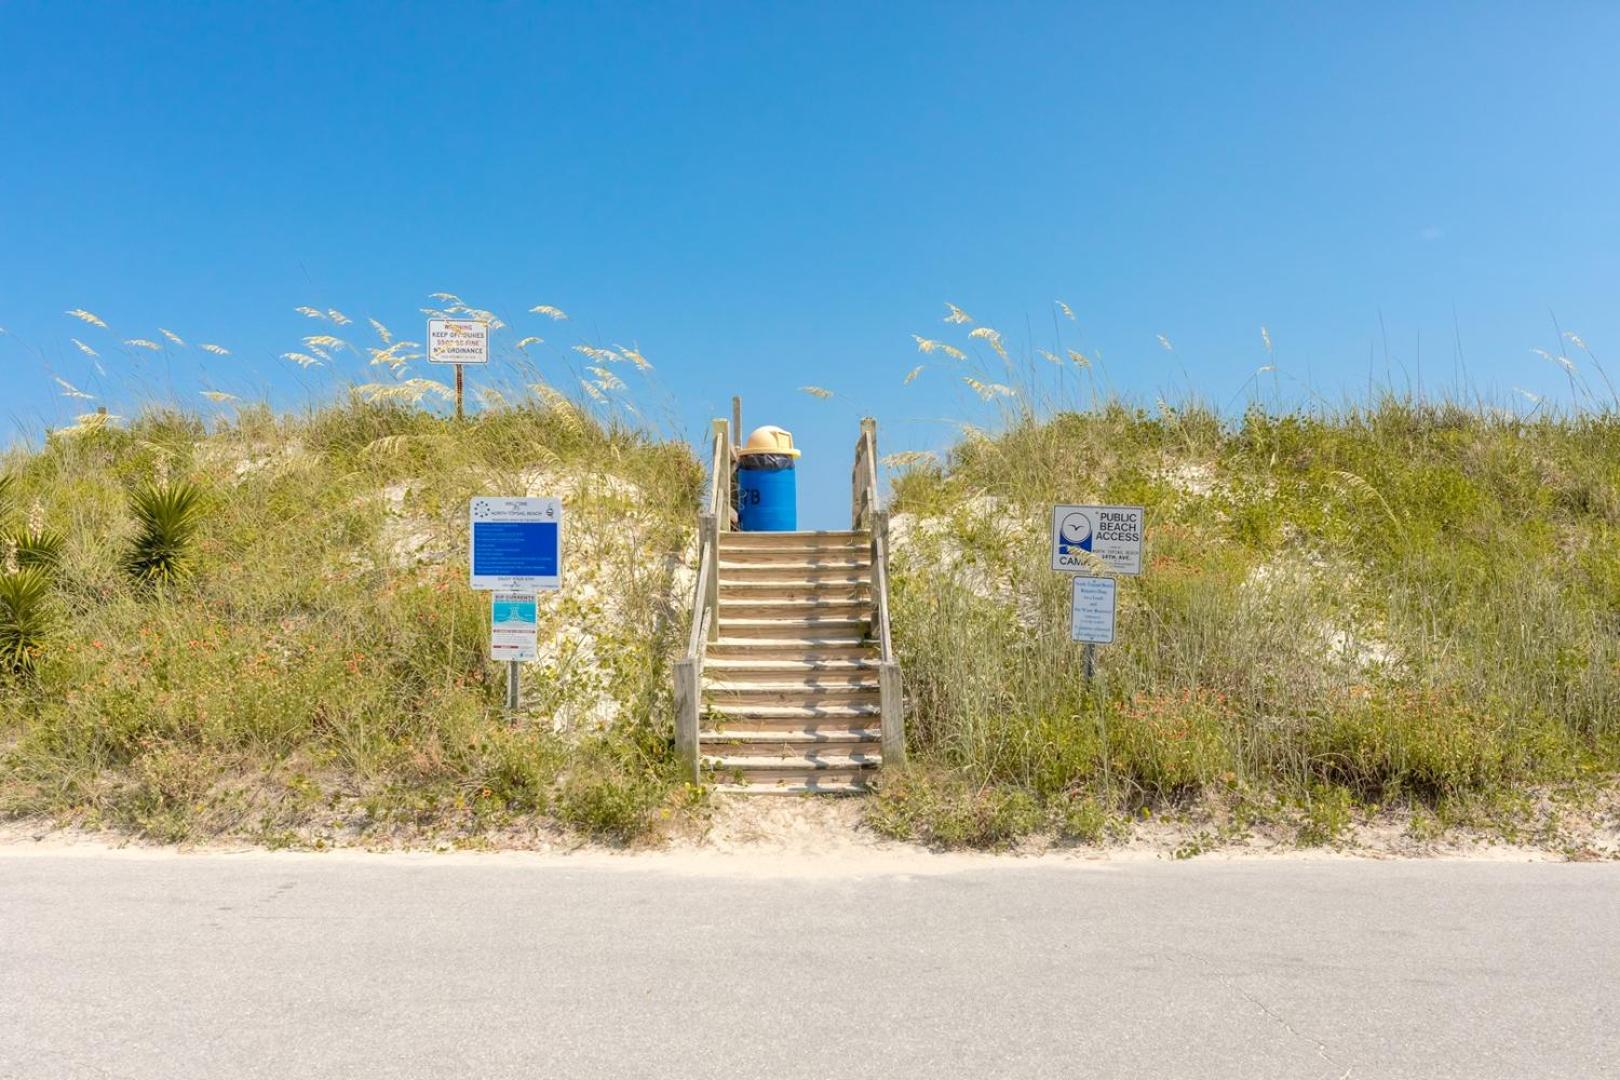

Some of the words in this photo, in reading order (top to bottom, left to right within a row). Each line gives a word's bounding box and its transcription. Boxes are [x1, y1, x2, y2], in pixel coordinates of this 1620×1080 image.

[1100, 512, 1137, 522] PUBLIC
[1100, 522, 1137, 532] BEACH
[1095, 532, 1139, 542] ACCESS
